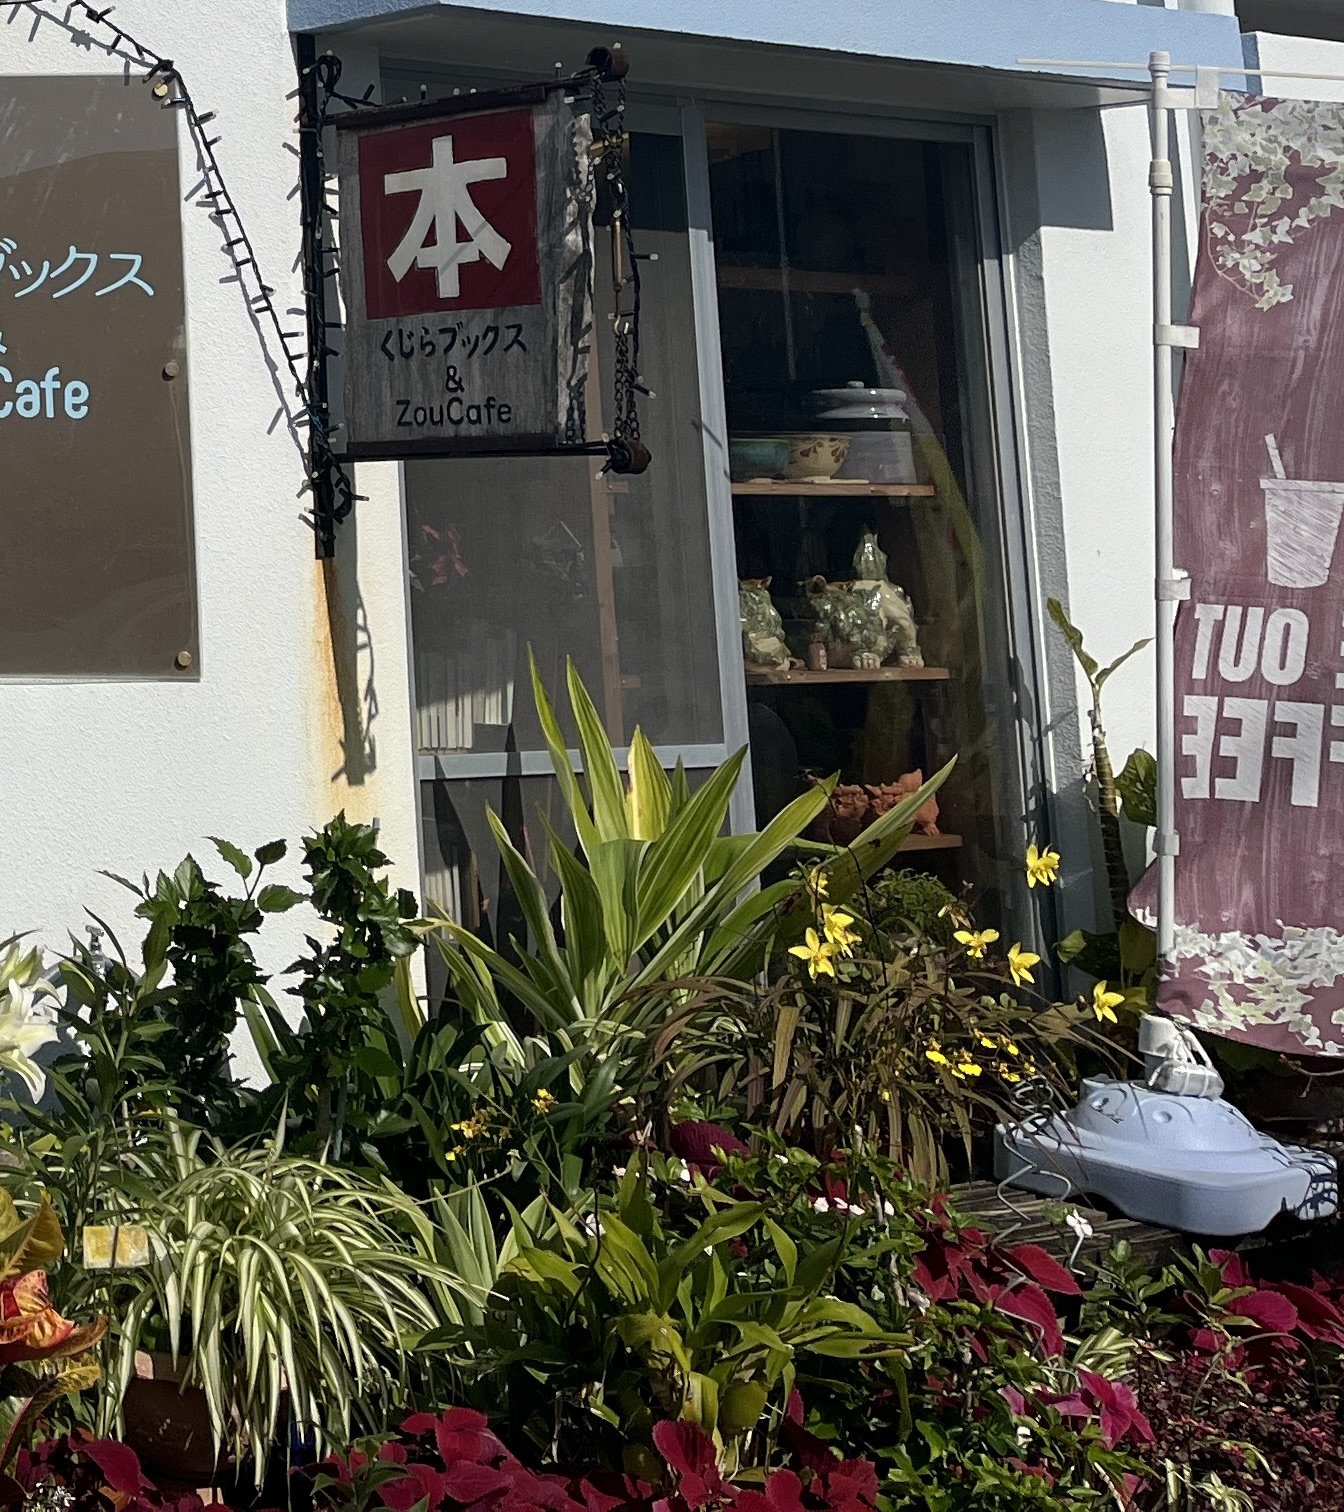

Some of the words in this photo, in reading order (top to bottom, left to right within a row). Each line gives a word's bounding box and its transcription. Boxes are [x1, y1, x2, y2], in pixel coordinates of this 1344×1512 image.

[384, 134, 512, 299] 本
[380, 321, 528, 362] くじらブックス
[445, 365, 465, 393] &
[395, 396, 513, 427] ZouCafe
